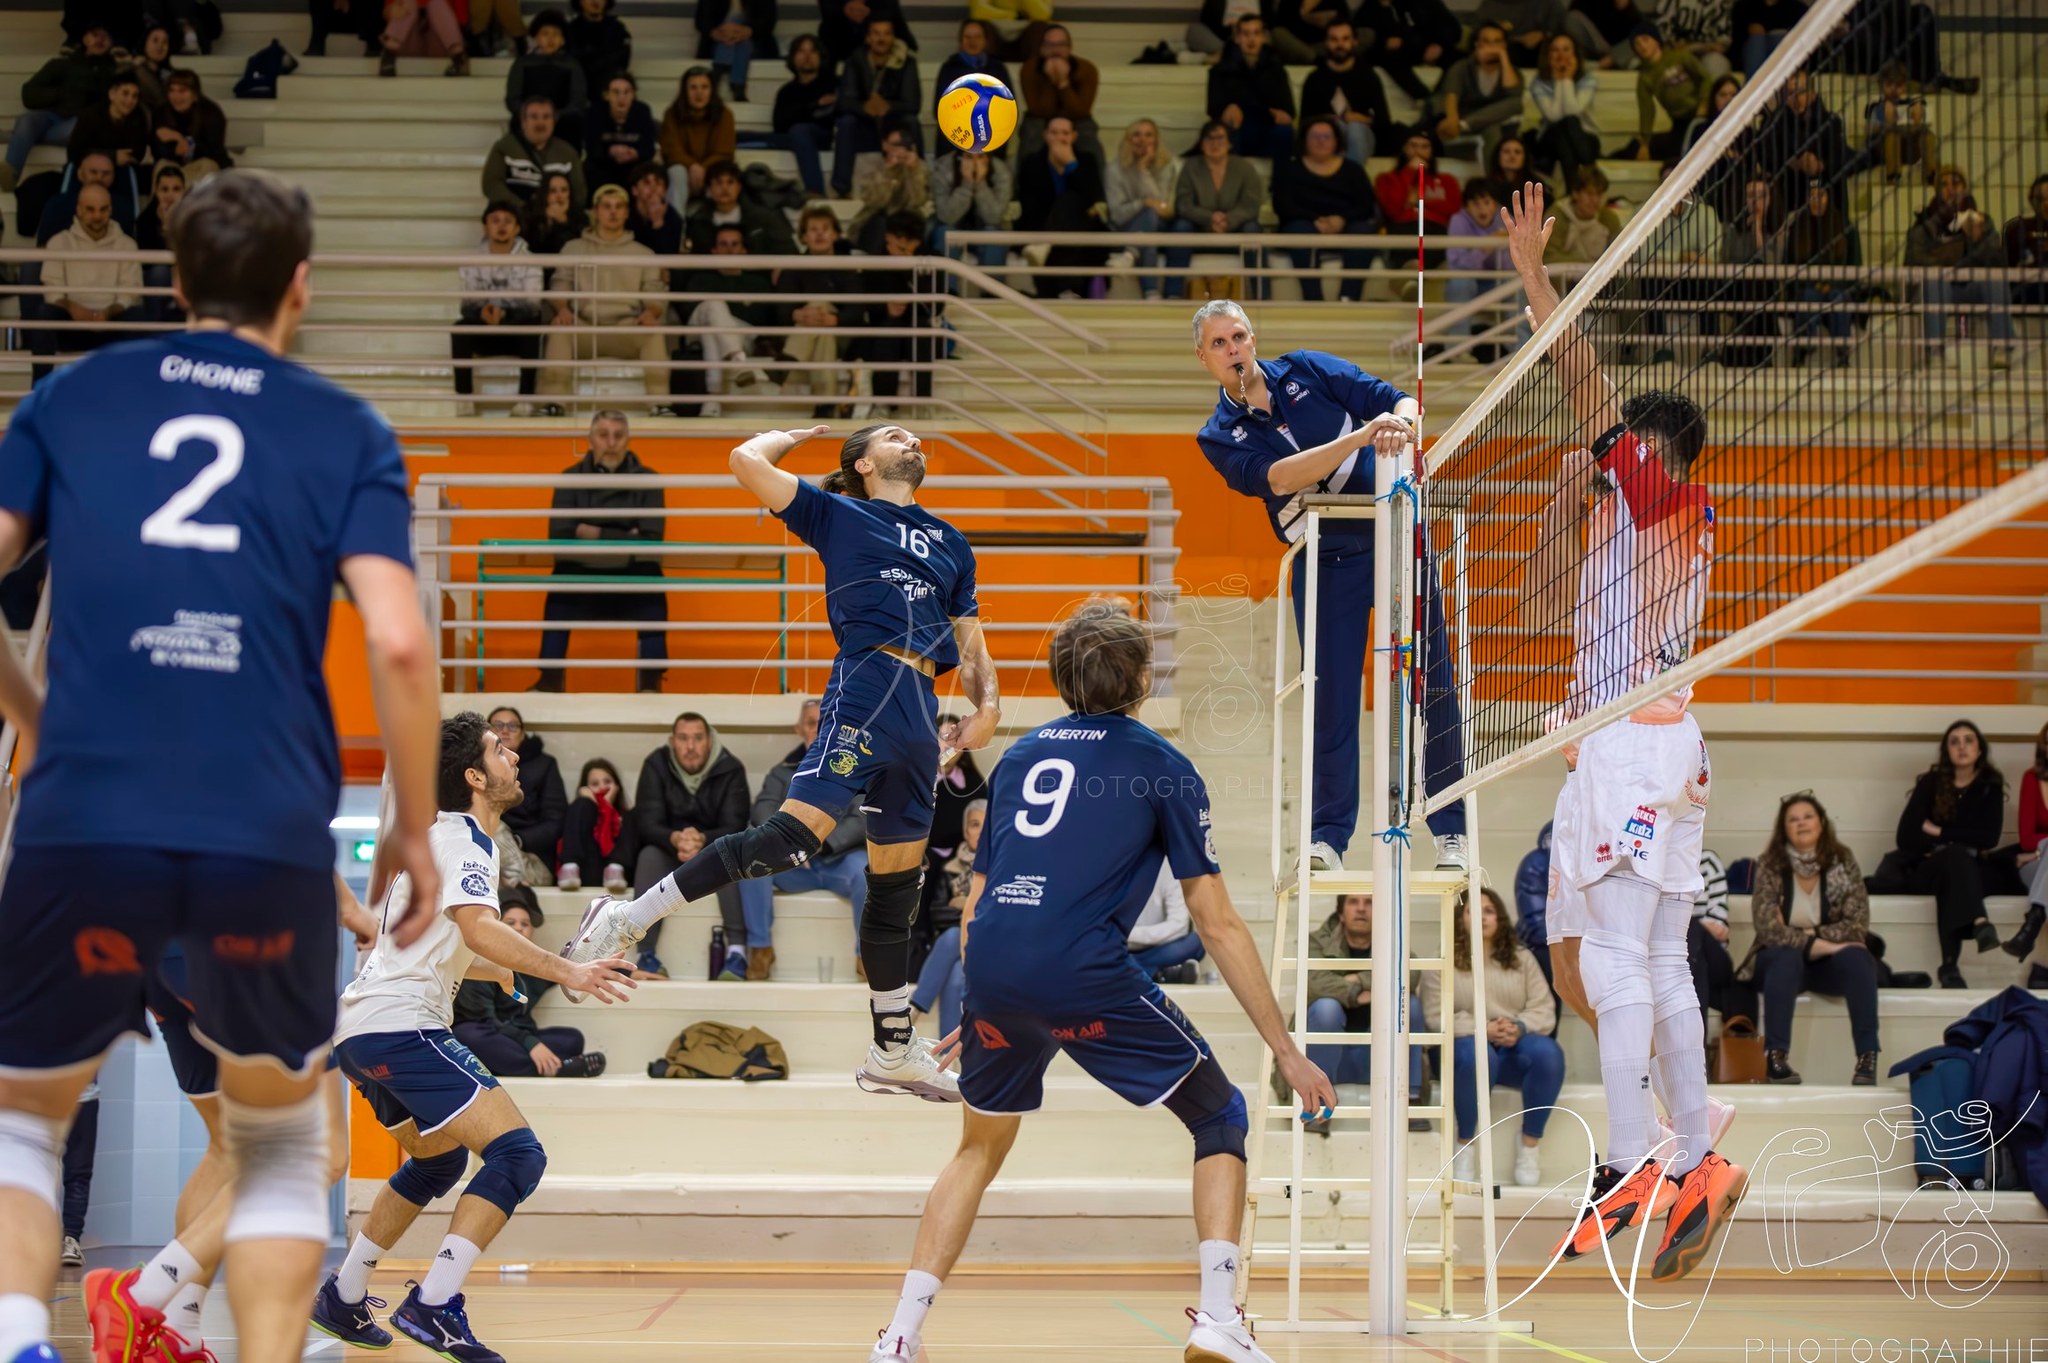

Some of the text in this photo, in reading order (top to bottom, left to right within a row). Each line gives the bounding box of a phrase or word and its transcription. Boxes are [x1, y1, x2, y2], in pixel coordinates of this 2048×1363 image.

[140, 413, 245, 553] 2
[895, 522, 930, 559] 16
[1038, 728, 1108, 741] GUERTIN
[1014, 758, 1076, 838] 9
[1051, 1020, 1104, 1040] ON AIR
